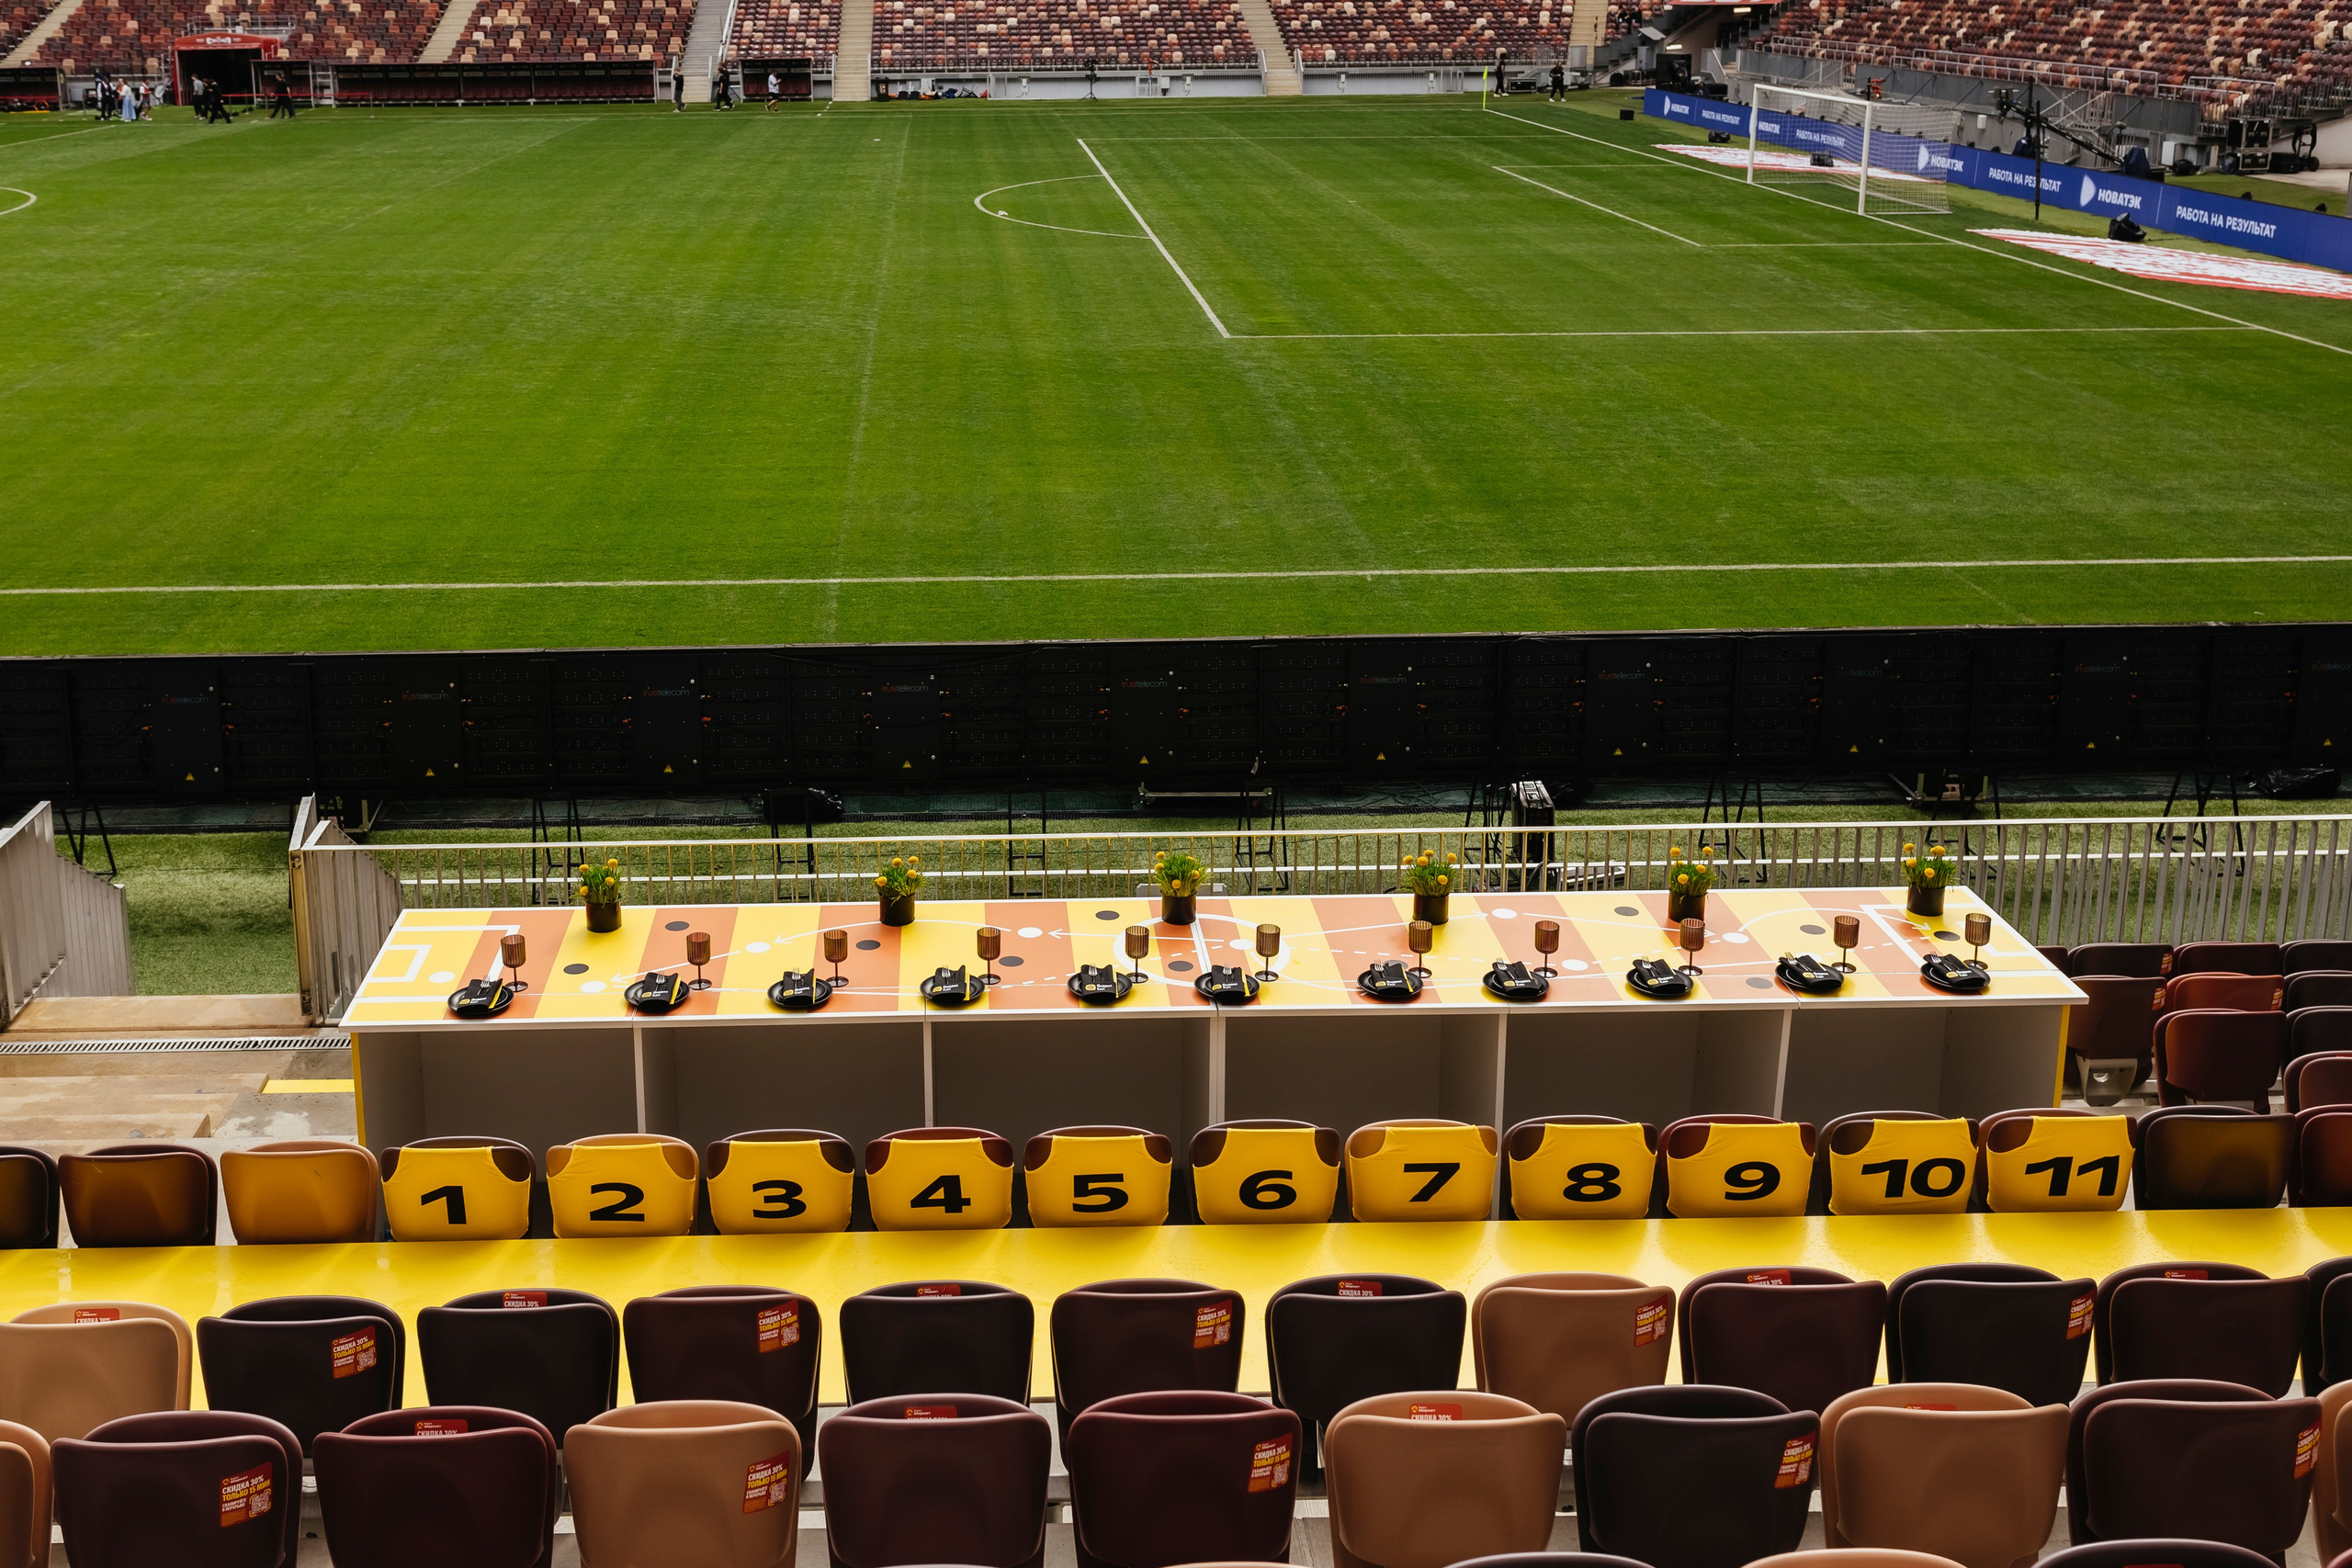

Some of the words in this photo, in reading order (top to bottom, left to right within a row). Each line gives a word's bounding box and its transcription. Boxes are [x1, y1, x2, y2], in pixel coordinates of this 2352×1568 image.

[1671, 103, 1690, 115] НОВАТЭК
[1702, 109, 1716, 120] РАБОТА
[1758, 121, 1781, 134] НОВАТЭК
[1796, 129, 1814, 141] РАБОТА
[1815, 132, 1819, 142] НА
[1930, 154, 1964, 173] НОВАТЭК
[1988, 167, 2012, 183] РАБОТА
[2013, 174, 2023, 185] НА
[2098, 187, 2142, 209] НОВАТЭК
[2176, 205, 2209, 224] РАБОТА
[2210, 212, 2224, 227] НА
[2225, 215, 2277, 238] РЕЗУЛЬТАТ
[1121, 680, 1167, 688] trusttelecom
[1404, 1163, 1460, 1201] 7
[1564, 1163, 1621, 1201] 8
[1724, 1162, 1780, 1201] 9
[1861, 1158, 1965, 1198] 10
[2025, 1156, 2120, 1196] 11
[753, 1180, 806, 1218] 3
[910, 1176, 970, 1213] 4
[1073, 1174, 1128, 1213] 5
[1239, 1170, 1296, 1210] 6
[422, 1186, 467, 1224] 1
[590, 1183, 644, 1222] 2
[759, 1314, 780, 1325] СКИДКА
[759, 1321, 780, 1332] ТОЛЬКО
[334, 1341, 356, 1353] СКИДКА
[334, 1348, 356, 1359] ТОЛЬКО
[222, 1481, 250, 1494] СКИДКА
[250, 1474, 264, 1486] 30%
[748, 1469, 771, 1481] СКИДКА
[748, 1476, 770, 1489] ТОЛЬКО
[222, 1488, 248, 1501] ТОЛЬКО
[249, 1485, 255, 1494] 15
